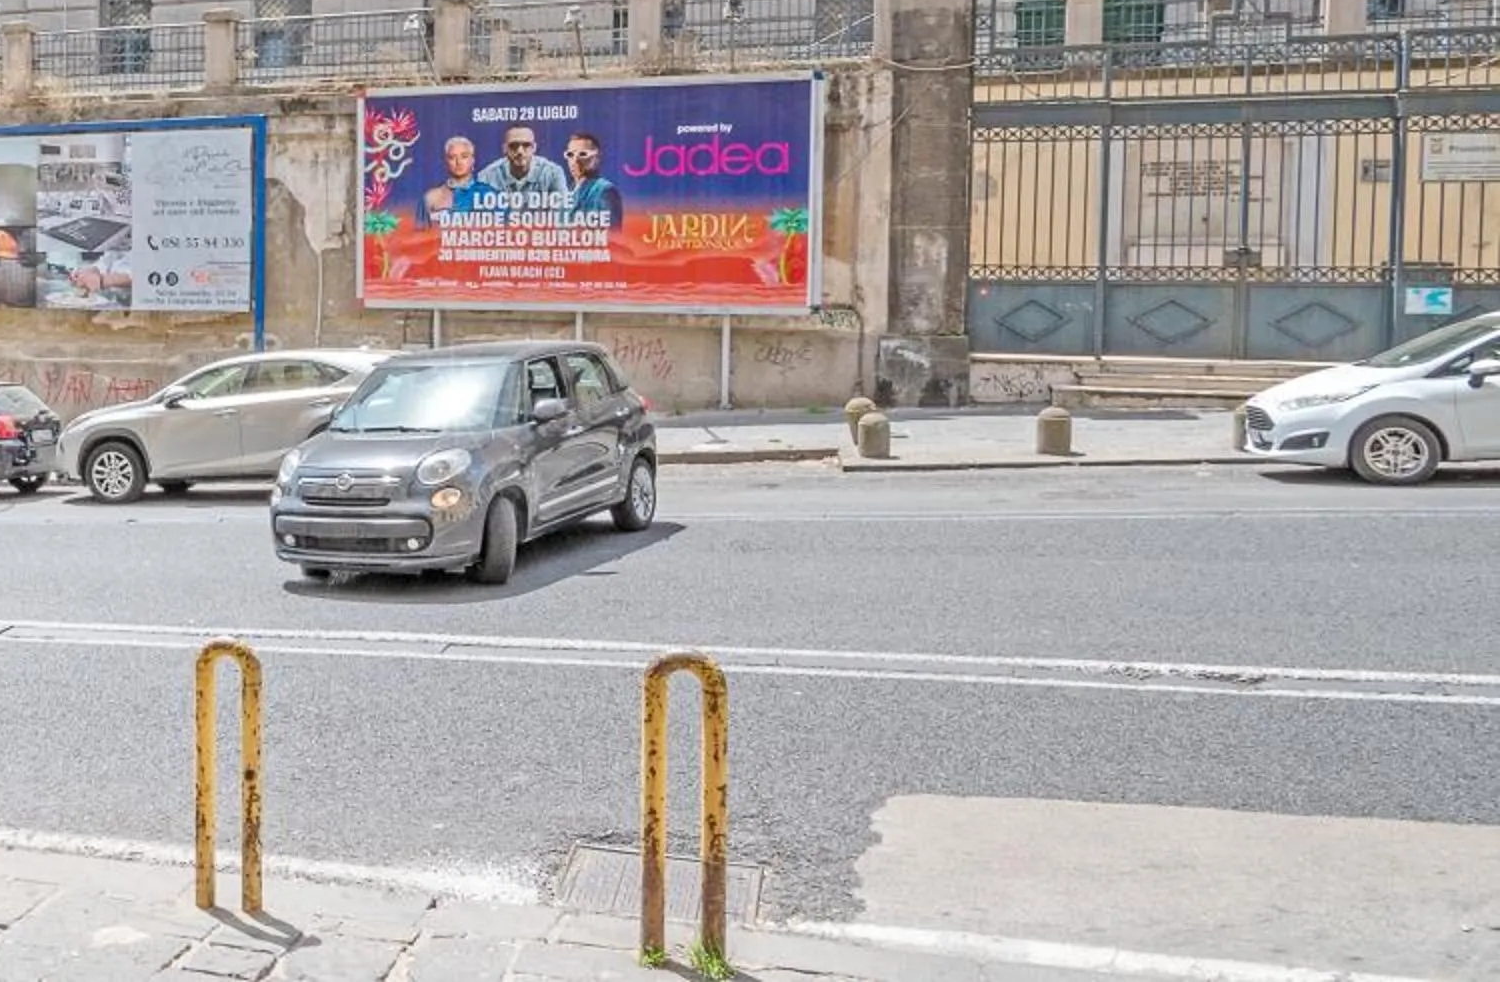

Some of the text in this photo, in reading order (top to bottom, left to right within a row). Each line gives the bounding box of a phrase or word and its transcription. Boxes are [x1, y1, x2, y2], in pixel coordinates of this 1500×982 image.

[472, 105, 578, 122] SABATO 29 LUGLIO
[676, 122, 733, 135] powered by
[623, 135, 790, 177] Jadea
[473, 191, 574, 210] LOCO DICE
[438, 210, 611, 228] DAVIDE SQUILLACE
[643, 212, 754, 244] JARDIN
[441, 229, 608, 247] MARCELO BURLON
[509, 266, 543, 278] BEACH
